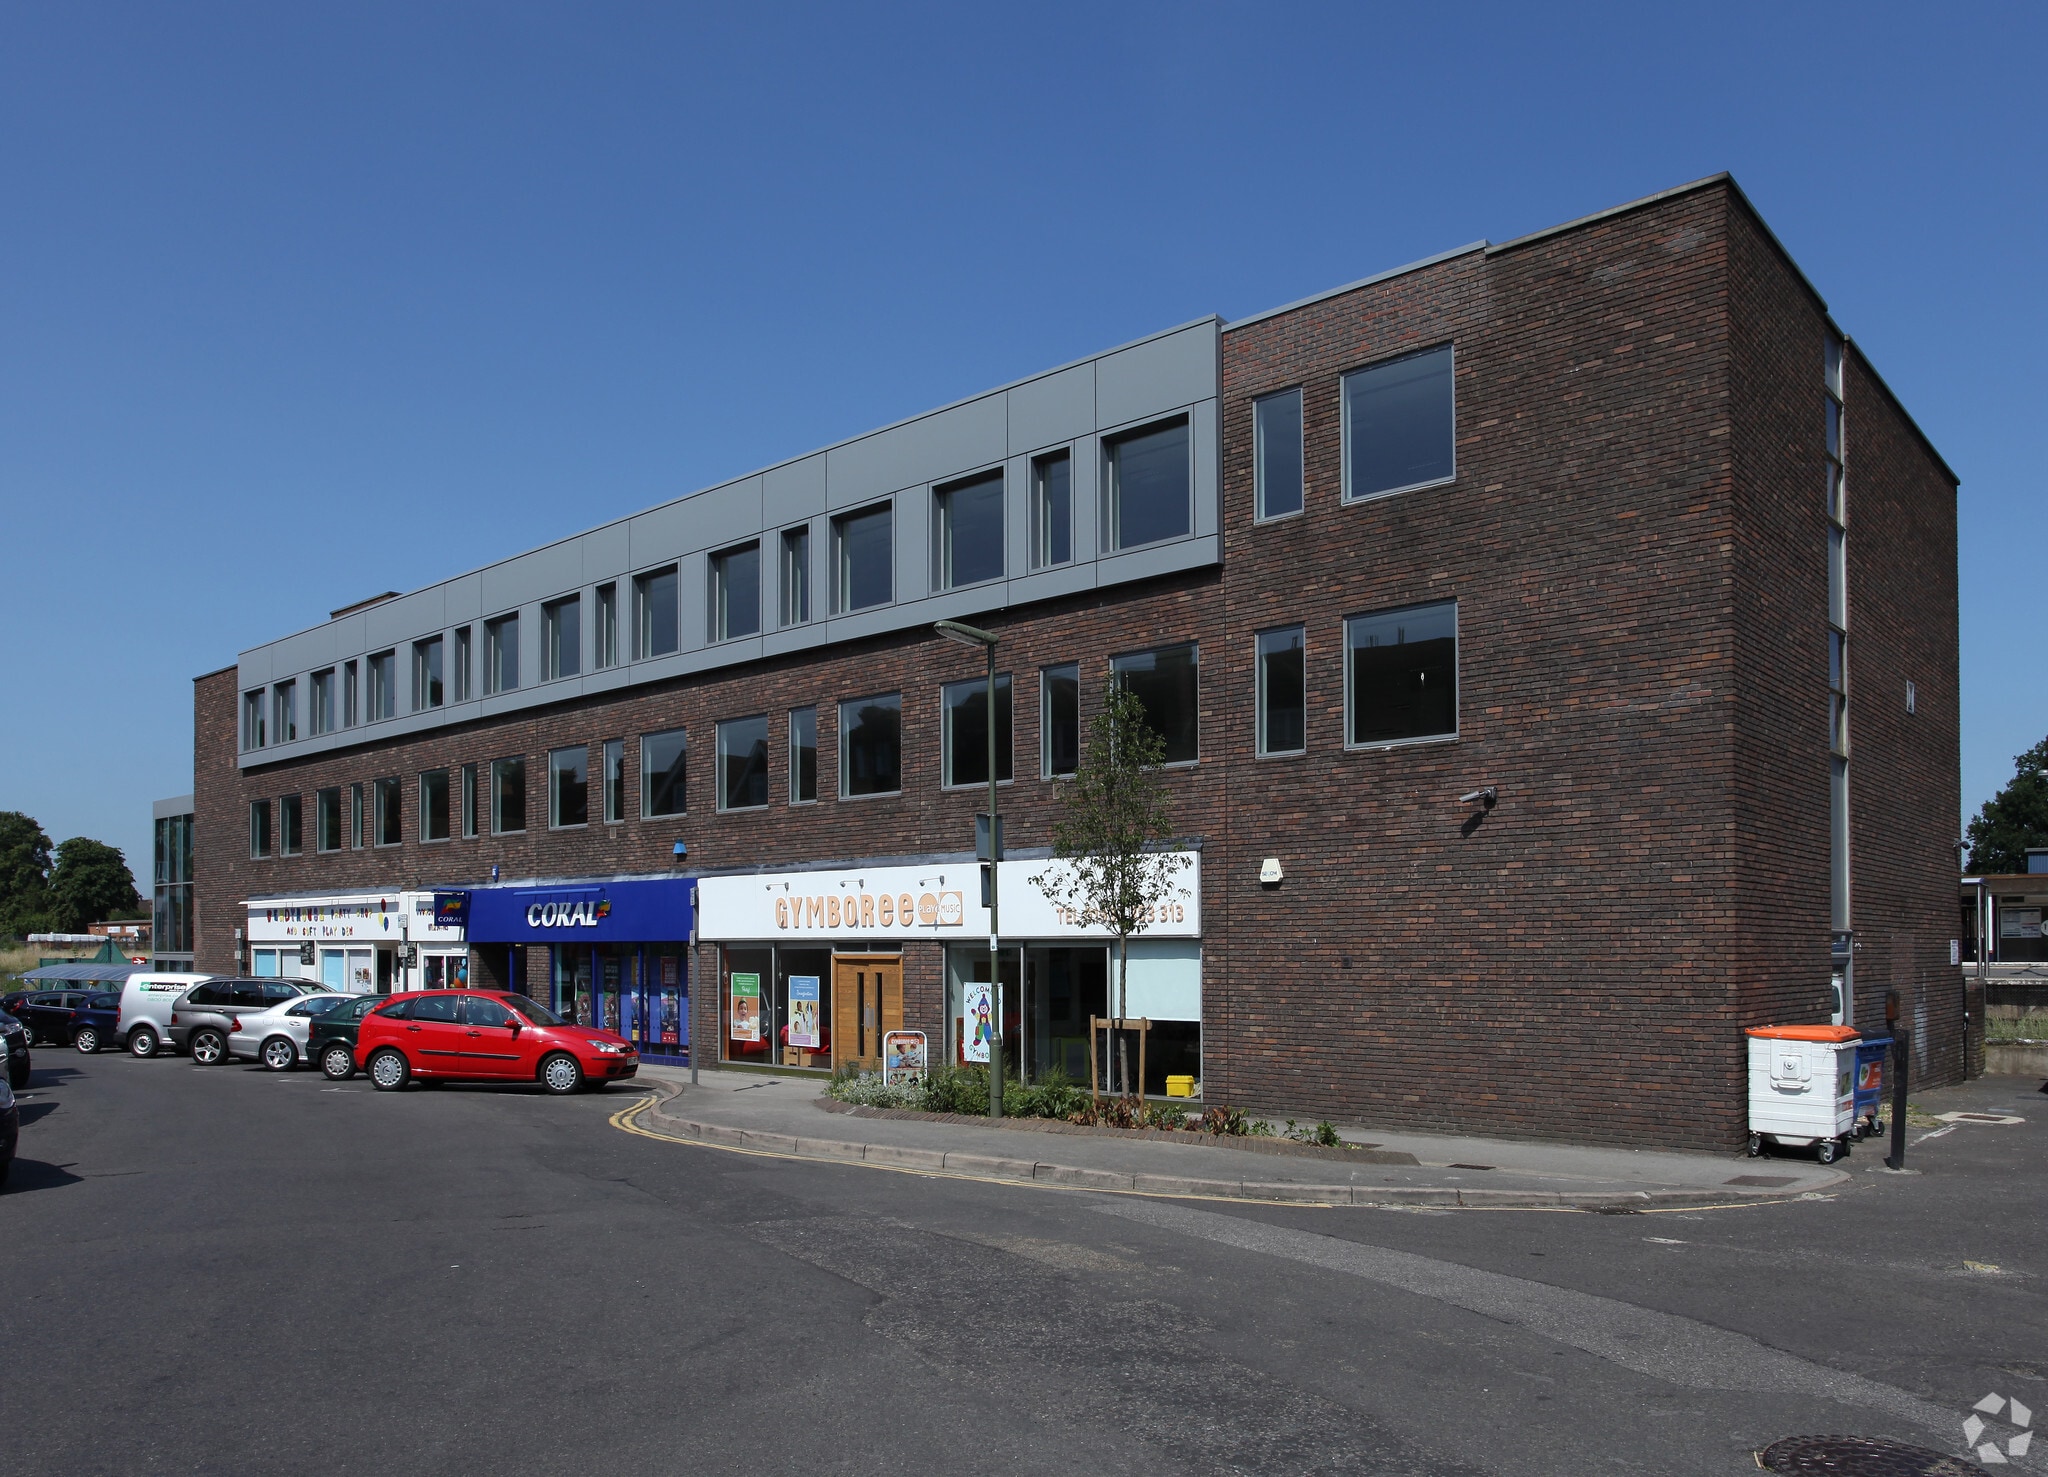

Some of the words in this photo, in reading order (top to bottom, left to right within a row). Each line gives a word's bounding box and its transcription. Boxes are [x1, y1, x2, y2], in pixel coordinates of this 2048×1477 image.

[331, 908, 351, 920] PARTY
[527, 901, 597, 927] CORAL
[1160, 904, 1184, 923] 313
[302, 926, 317, 937] SOFT
[322, 925, 338, 937] PLAY
[142, 983, 185, 991] enterprise
[965, 985, 993, 1005] WELCOM
